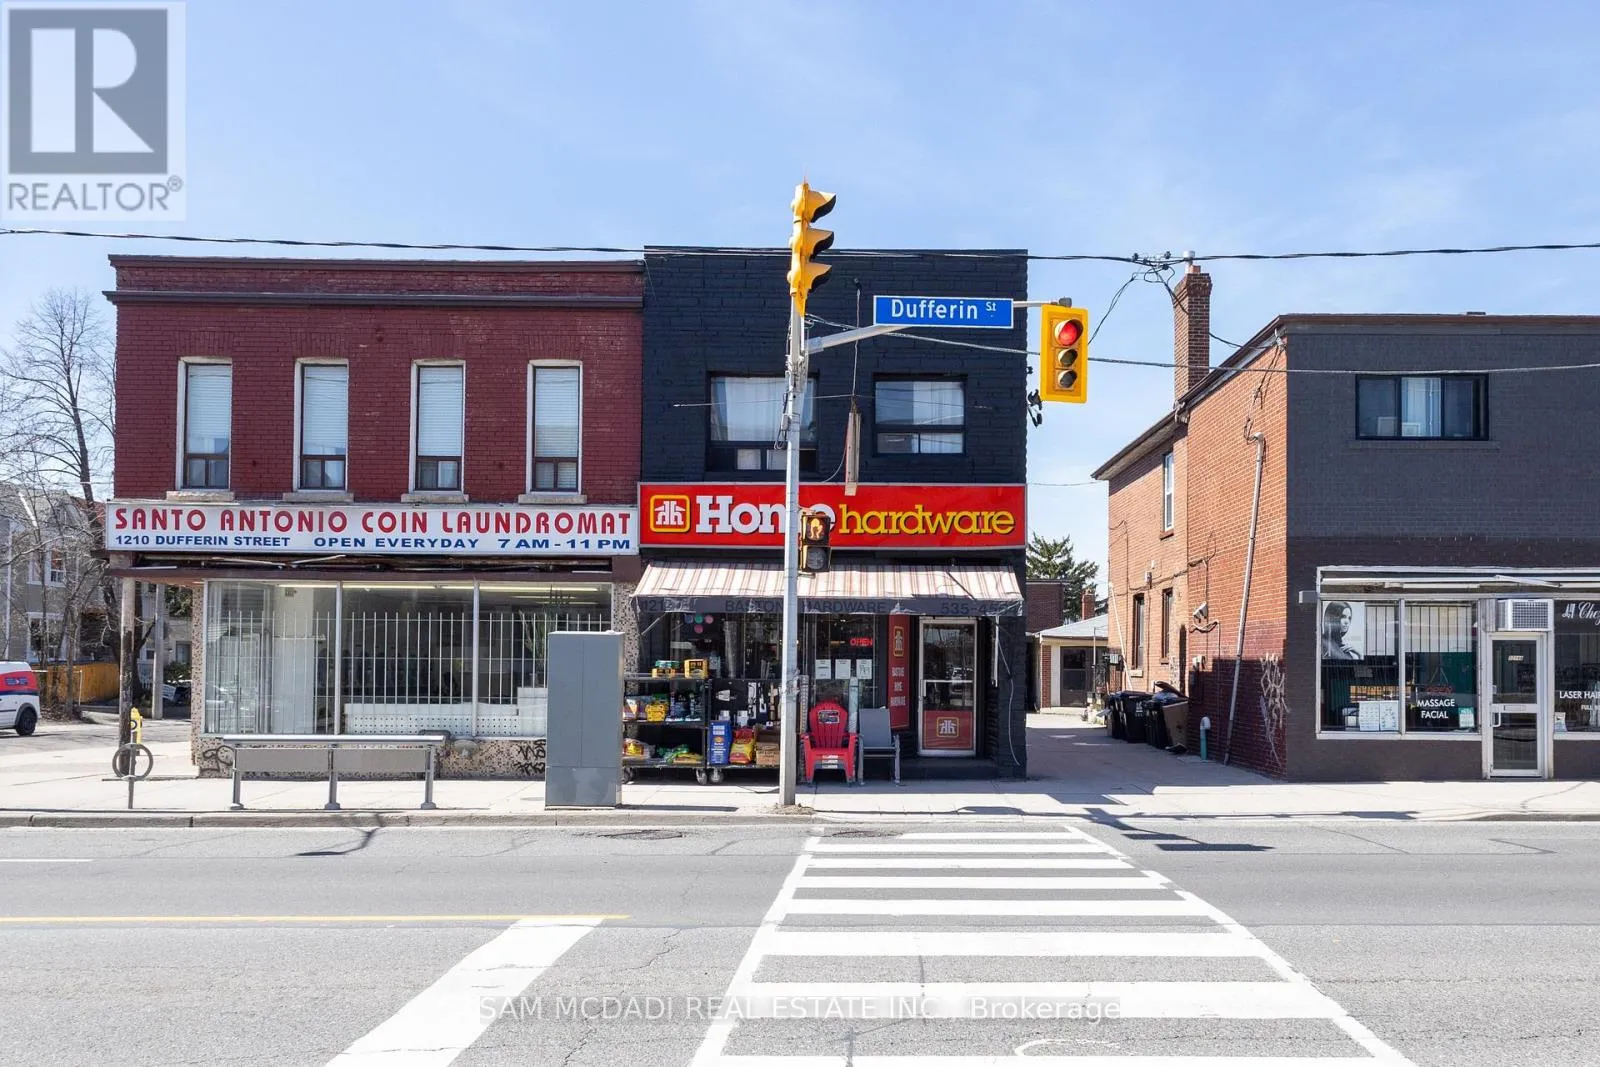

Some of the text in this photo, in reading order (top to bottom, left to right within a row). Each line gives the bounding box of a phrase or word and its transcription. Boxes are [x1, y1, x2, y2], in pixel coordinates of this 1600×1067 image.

[891, 299, 997, 319] Dufferin St
[115, 508, 631, 534] SANTO ANTONIO COIN LAUNDROMAT
[838, 503, 1015, 535] hardware
[115, 535, 149, 545] 1210
[155, 535, 228, 546] DUFFERIN
[233, 536, 291, 547] STREET
[314, 537, 366, 548] OPEN
[375, 538, 479, 548] EVERYDAY
[1559, 690, 1600, 699] LASER HAI
[1416, 698, 1455, 707] MASSAGE
[1420, 710, 1449, 719] FACIAL
